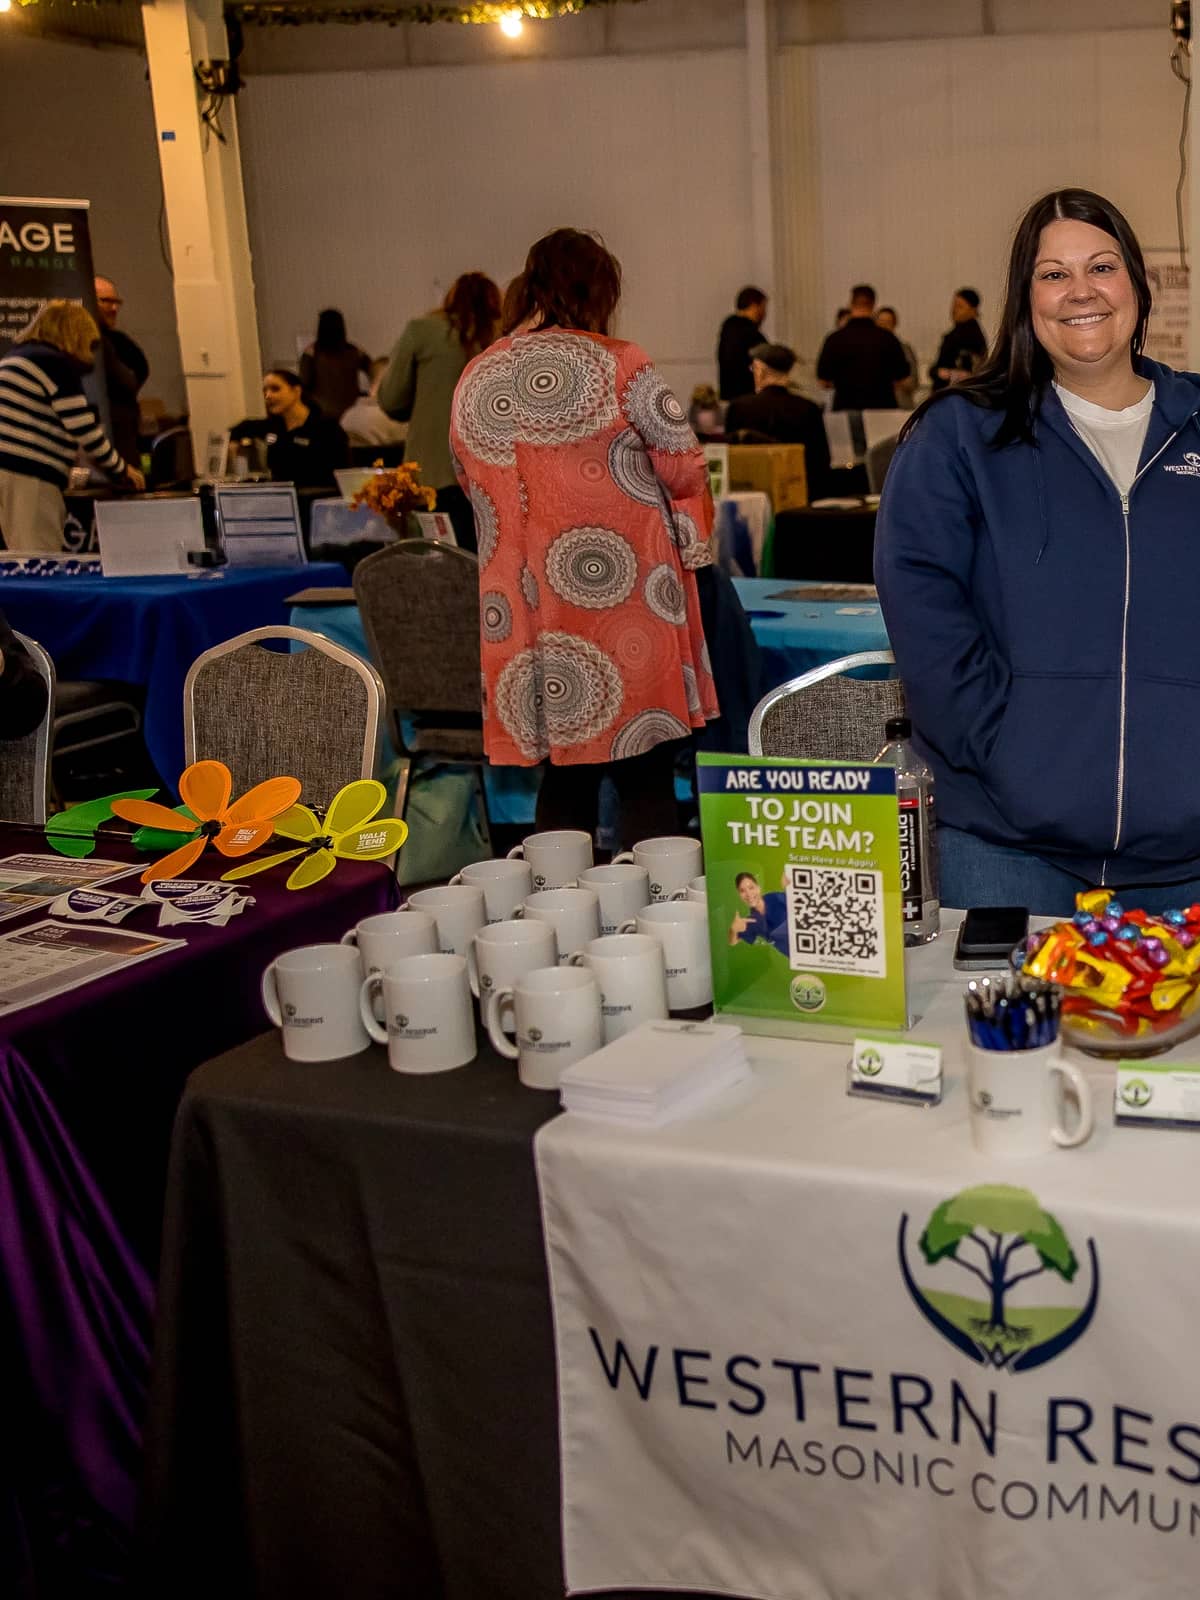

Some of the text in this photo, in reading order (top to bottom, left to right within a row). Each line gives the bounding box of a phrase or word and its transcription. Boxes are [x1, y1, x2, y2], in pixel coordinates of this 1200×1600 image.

[725, 769, 871, 791] ARE YOU READY
[745, 796, 853, 826] TO JOIN
[359, 831, 388, 841] WALK
[726, 821, 780, 848] THE
[784, 824, 875, 854] TEAM?
[788, 853, 809, 863] Scan
[589, 1326, 998, 1458] WESTERN
[726, 1430, 956, 1496] MASONIC
